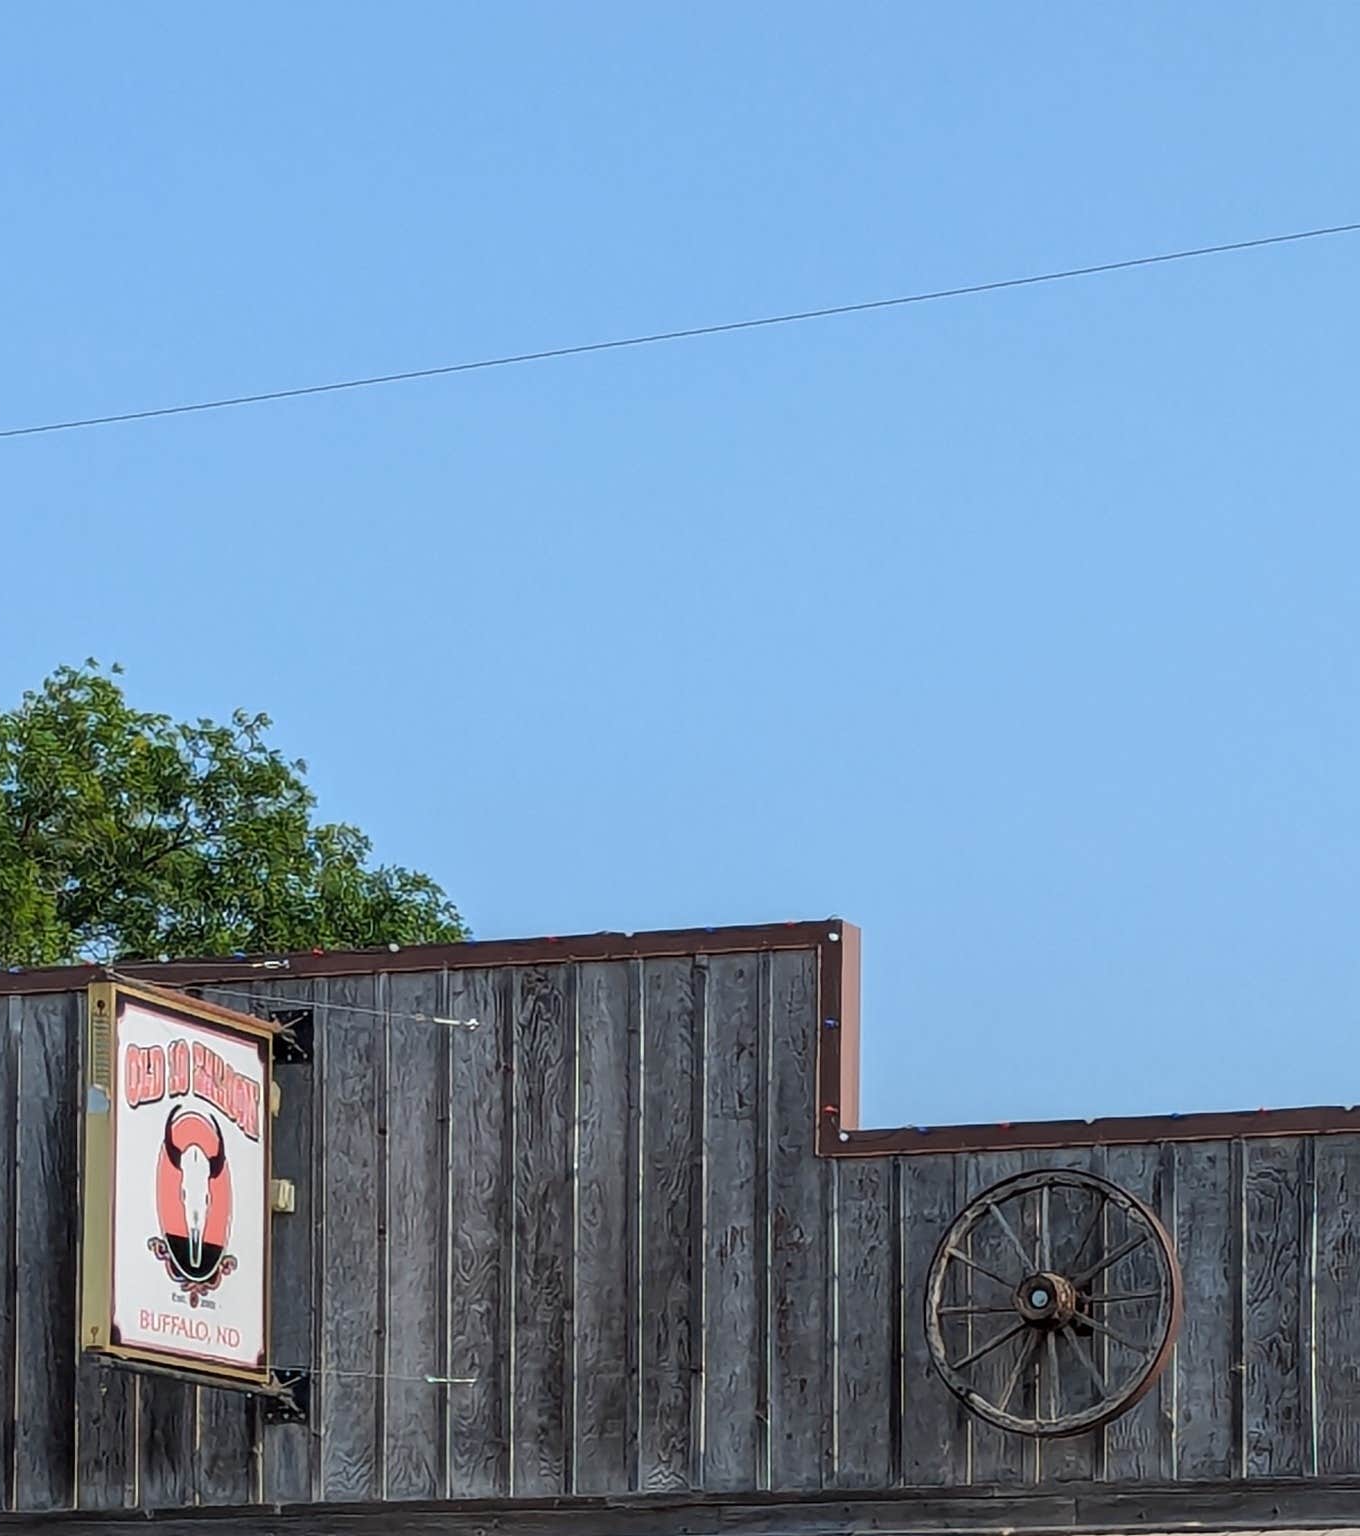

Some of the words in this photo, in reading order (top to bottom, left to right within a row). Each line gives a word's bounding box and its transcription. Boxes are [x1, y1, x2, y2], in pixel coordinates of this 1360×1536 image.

[125, 1043, 165, 1110] OLD
[140, 1309, 211, 1344] BUFFALO,
[217, 1327, 240, 1347] ND
